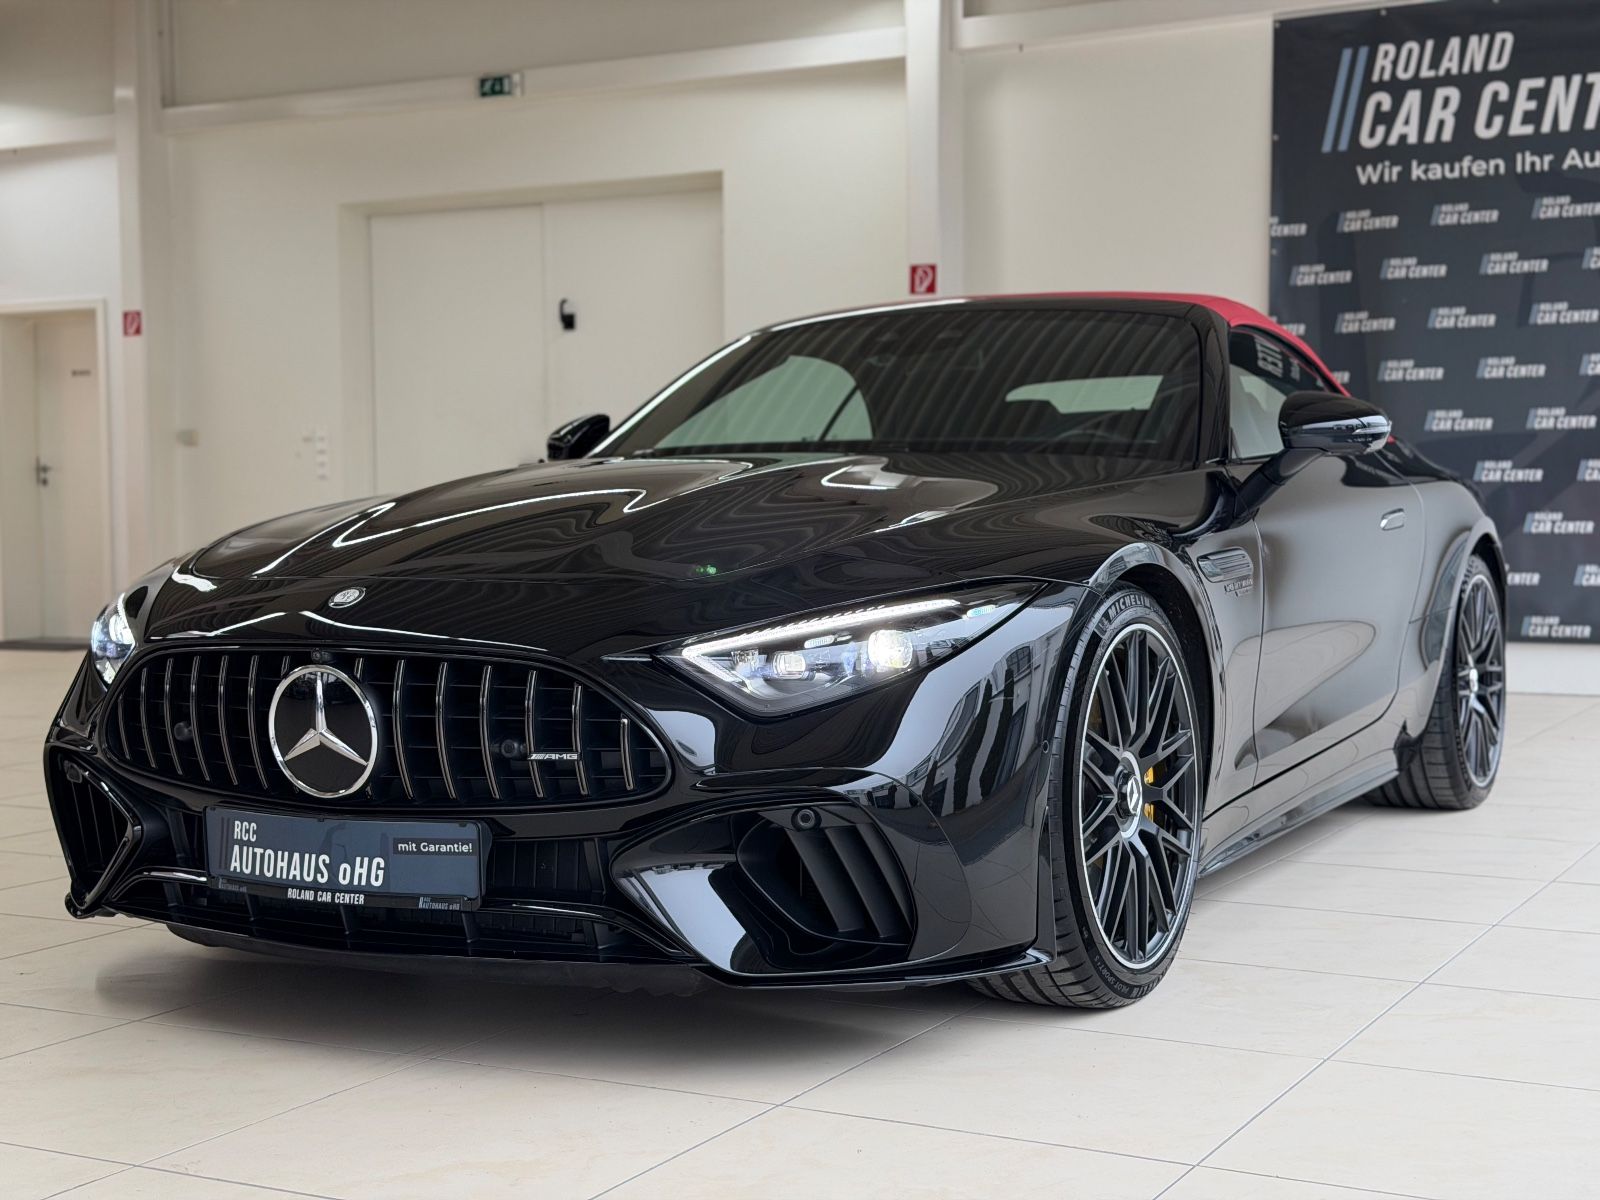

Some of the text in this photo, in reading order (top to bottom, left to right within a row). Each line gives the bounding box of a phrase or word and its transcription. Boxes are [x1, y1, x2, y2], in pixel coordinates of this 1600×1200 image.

[1371, 31, 1514, 82] ROLAND
[1359, 86, 1461, 149] CAR
[1356, 160, 1402, 185] Wir
[1411, 155, 1506, 181] kaufen
[1516, 150, 1554, 174] Ihr
[1438, 209, 1499, 226] CAR CENTER
[1539, 202, 1600, 219] CAR CENTER
[1343, 215, 1399, 232] CAR CENTER
[1387, 264, 1447, 280] CAR CENTER
[1487, 259, 1549, 275] CAR CENTER
[1296, 270, 1352, 286] CAR CENTER
[1435, 314, 1496, 329] CAR CENTER
[1537, 309, 1599, 325] CAR CENTER
[1341, 318, 1396, 333] CAR CENTER
[1384, 367, 1444, 381] CAR CENTER
[1484, 364, 1546, 379] CAR CENTER
[1432, 417, 1493, 432] CAR CENTER
[1534, 415, 1597, 430] CAR CENTER
[1481, 468, 1544, 482] CAR CENTER
[1531, 521, 1594, 534] CAR CENTER
[1507, 572, 1540, 587] ENTER
[1107, 594, 1151, 621] MICHELIN
[1528, 625, 1591, 638] CAR CENTER
[234, 820, 257, 842] RCC
[398, 841, 473, 853] mit Garantie!
[230, 844, 385, 887] AUTOHAUS oHG
[288, 888, 365, 905] ROLAND CAR CENTER
[422, 902, 449, 910] AUTOHAUS
